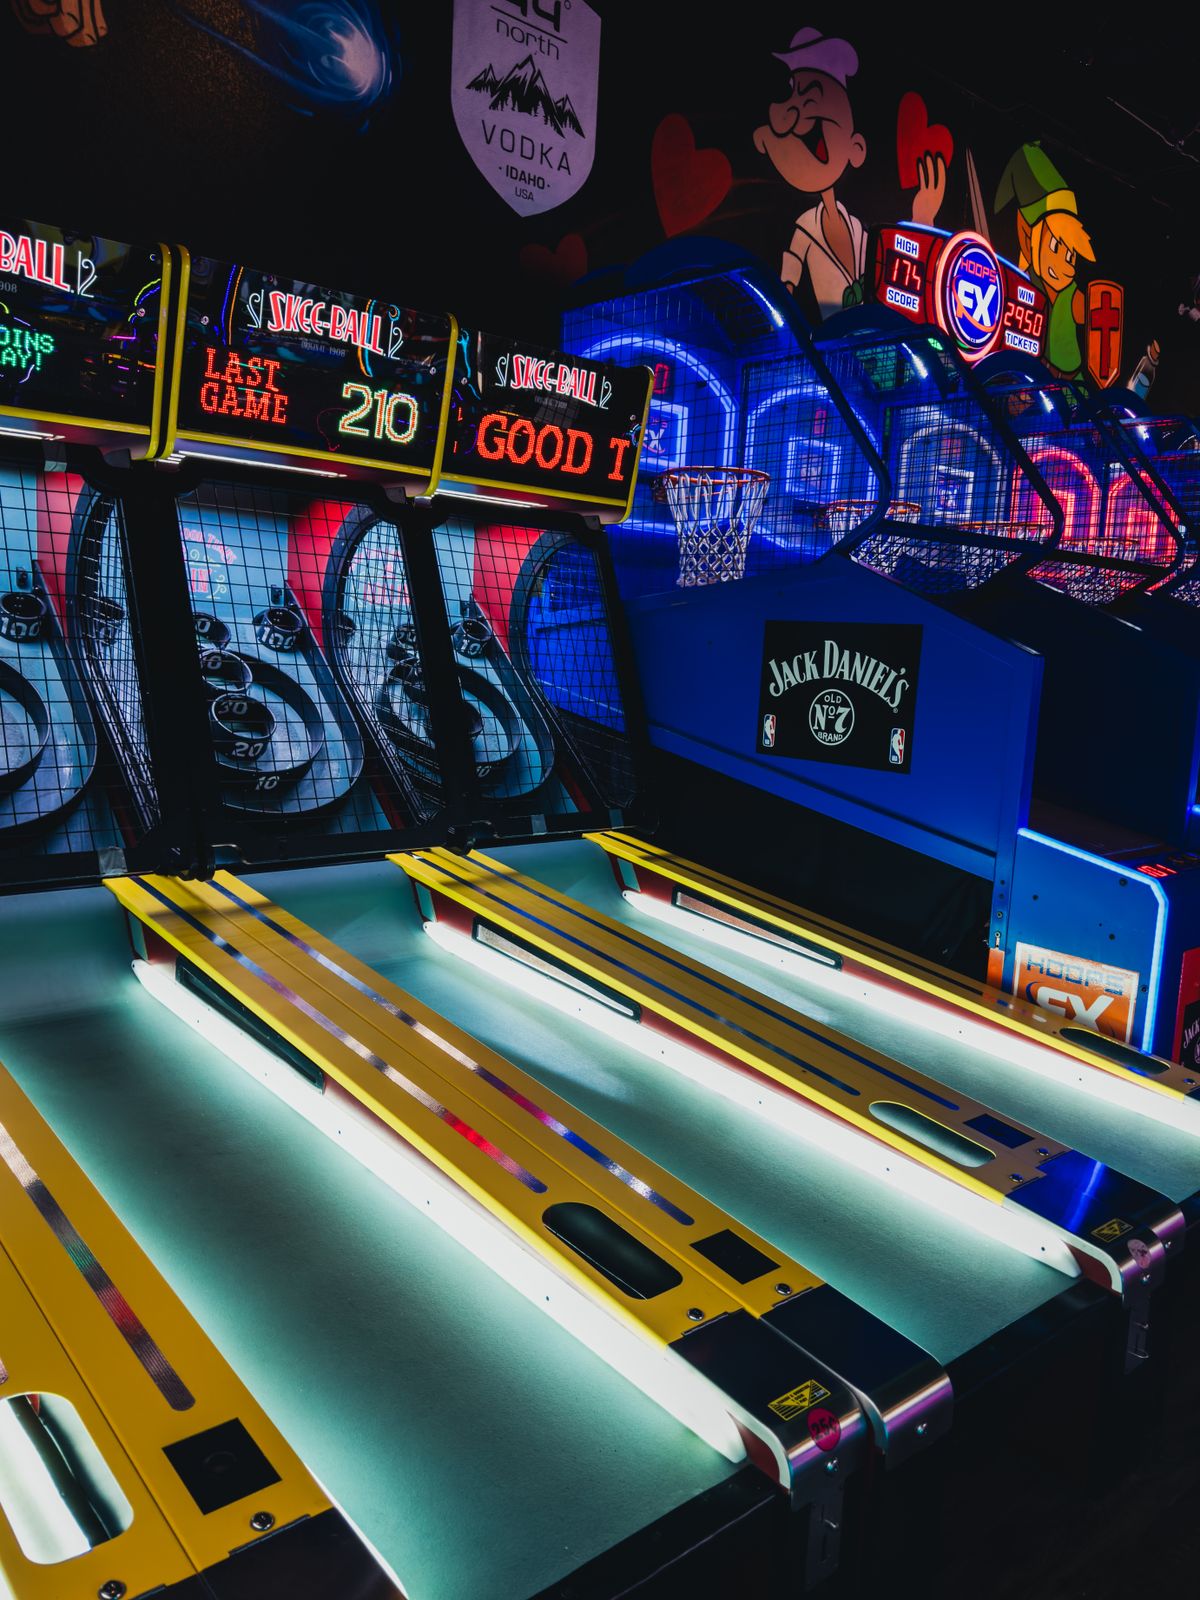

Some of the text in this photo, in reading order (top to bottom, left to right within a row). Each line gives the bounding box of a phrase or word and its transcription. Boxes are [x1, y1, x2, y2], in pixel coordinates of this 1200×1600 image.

[496, 18, 559, 60] north
[481, 119, 571, 175] VODKA
[505, 164, 545, 190] IDAHO
[514, 186, 535, 201] USA
[895, 235, 918, 256] HIGH
[960, 257, 997, 283] HOOPS
[887, 289, 918, 310] SCORE
[1018, 288, 1034, 304] WIN
[1003, 302, 1043, 337] 2950
[1006, 332, 1038, 353] TICKETS
[204, 348, 281, 392] LAST
[200, 381, 288, 424] GAME
[338, 382, 418, 443] 210
[476, 413, 630, 481] GOOD T
[259, 626, 297, 650] 100
[769, 640, 909, 708] JACK DANIEL'S
[824, 693, 842, 704] OLD
[231, 741, 264, 758] 20
[817, 731, 843, 742] BRAND
[255, 775, 280, 791] 10
[1026, 954, 1125, 996] HOOPS
